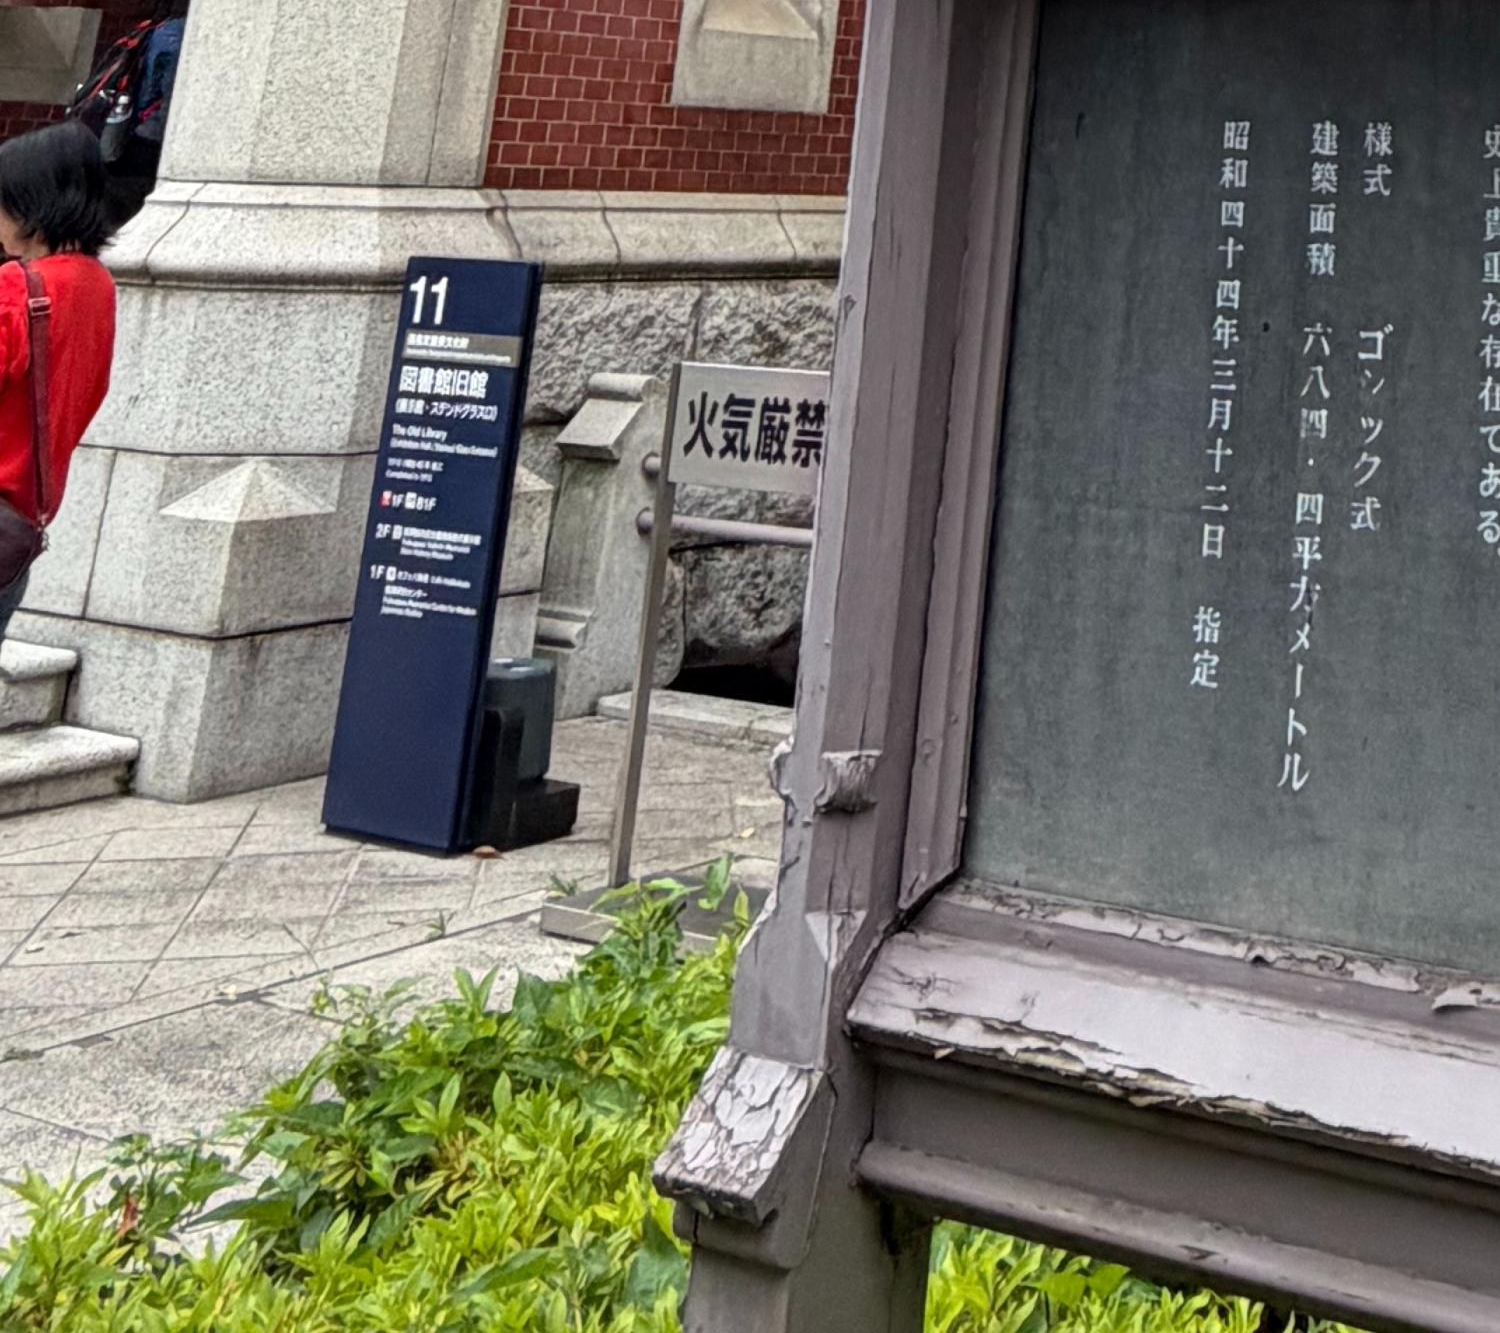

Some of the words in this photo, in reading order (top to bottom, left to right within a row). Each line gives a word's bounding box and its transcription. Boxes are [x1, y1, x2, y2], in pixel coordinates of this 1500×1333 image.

[1363, 121, 1393, 196] 様式
[1306, 120, 1339, 276] 建築面積
[409, 275, 449, 325] 11
[1200, 120, 1250, 559] 昭和四十四年三月十二日
[398, 364, 489, 399] 図書館旧館
[683, 391, 826, 468] 火気厳禁
[375, 523, 392, 539] 2F
[370, 564, 386, 579] 1F
[1190, 605, 1221, 689] 指定
